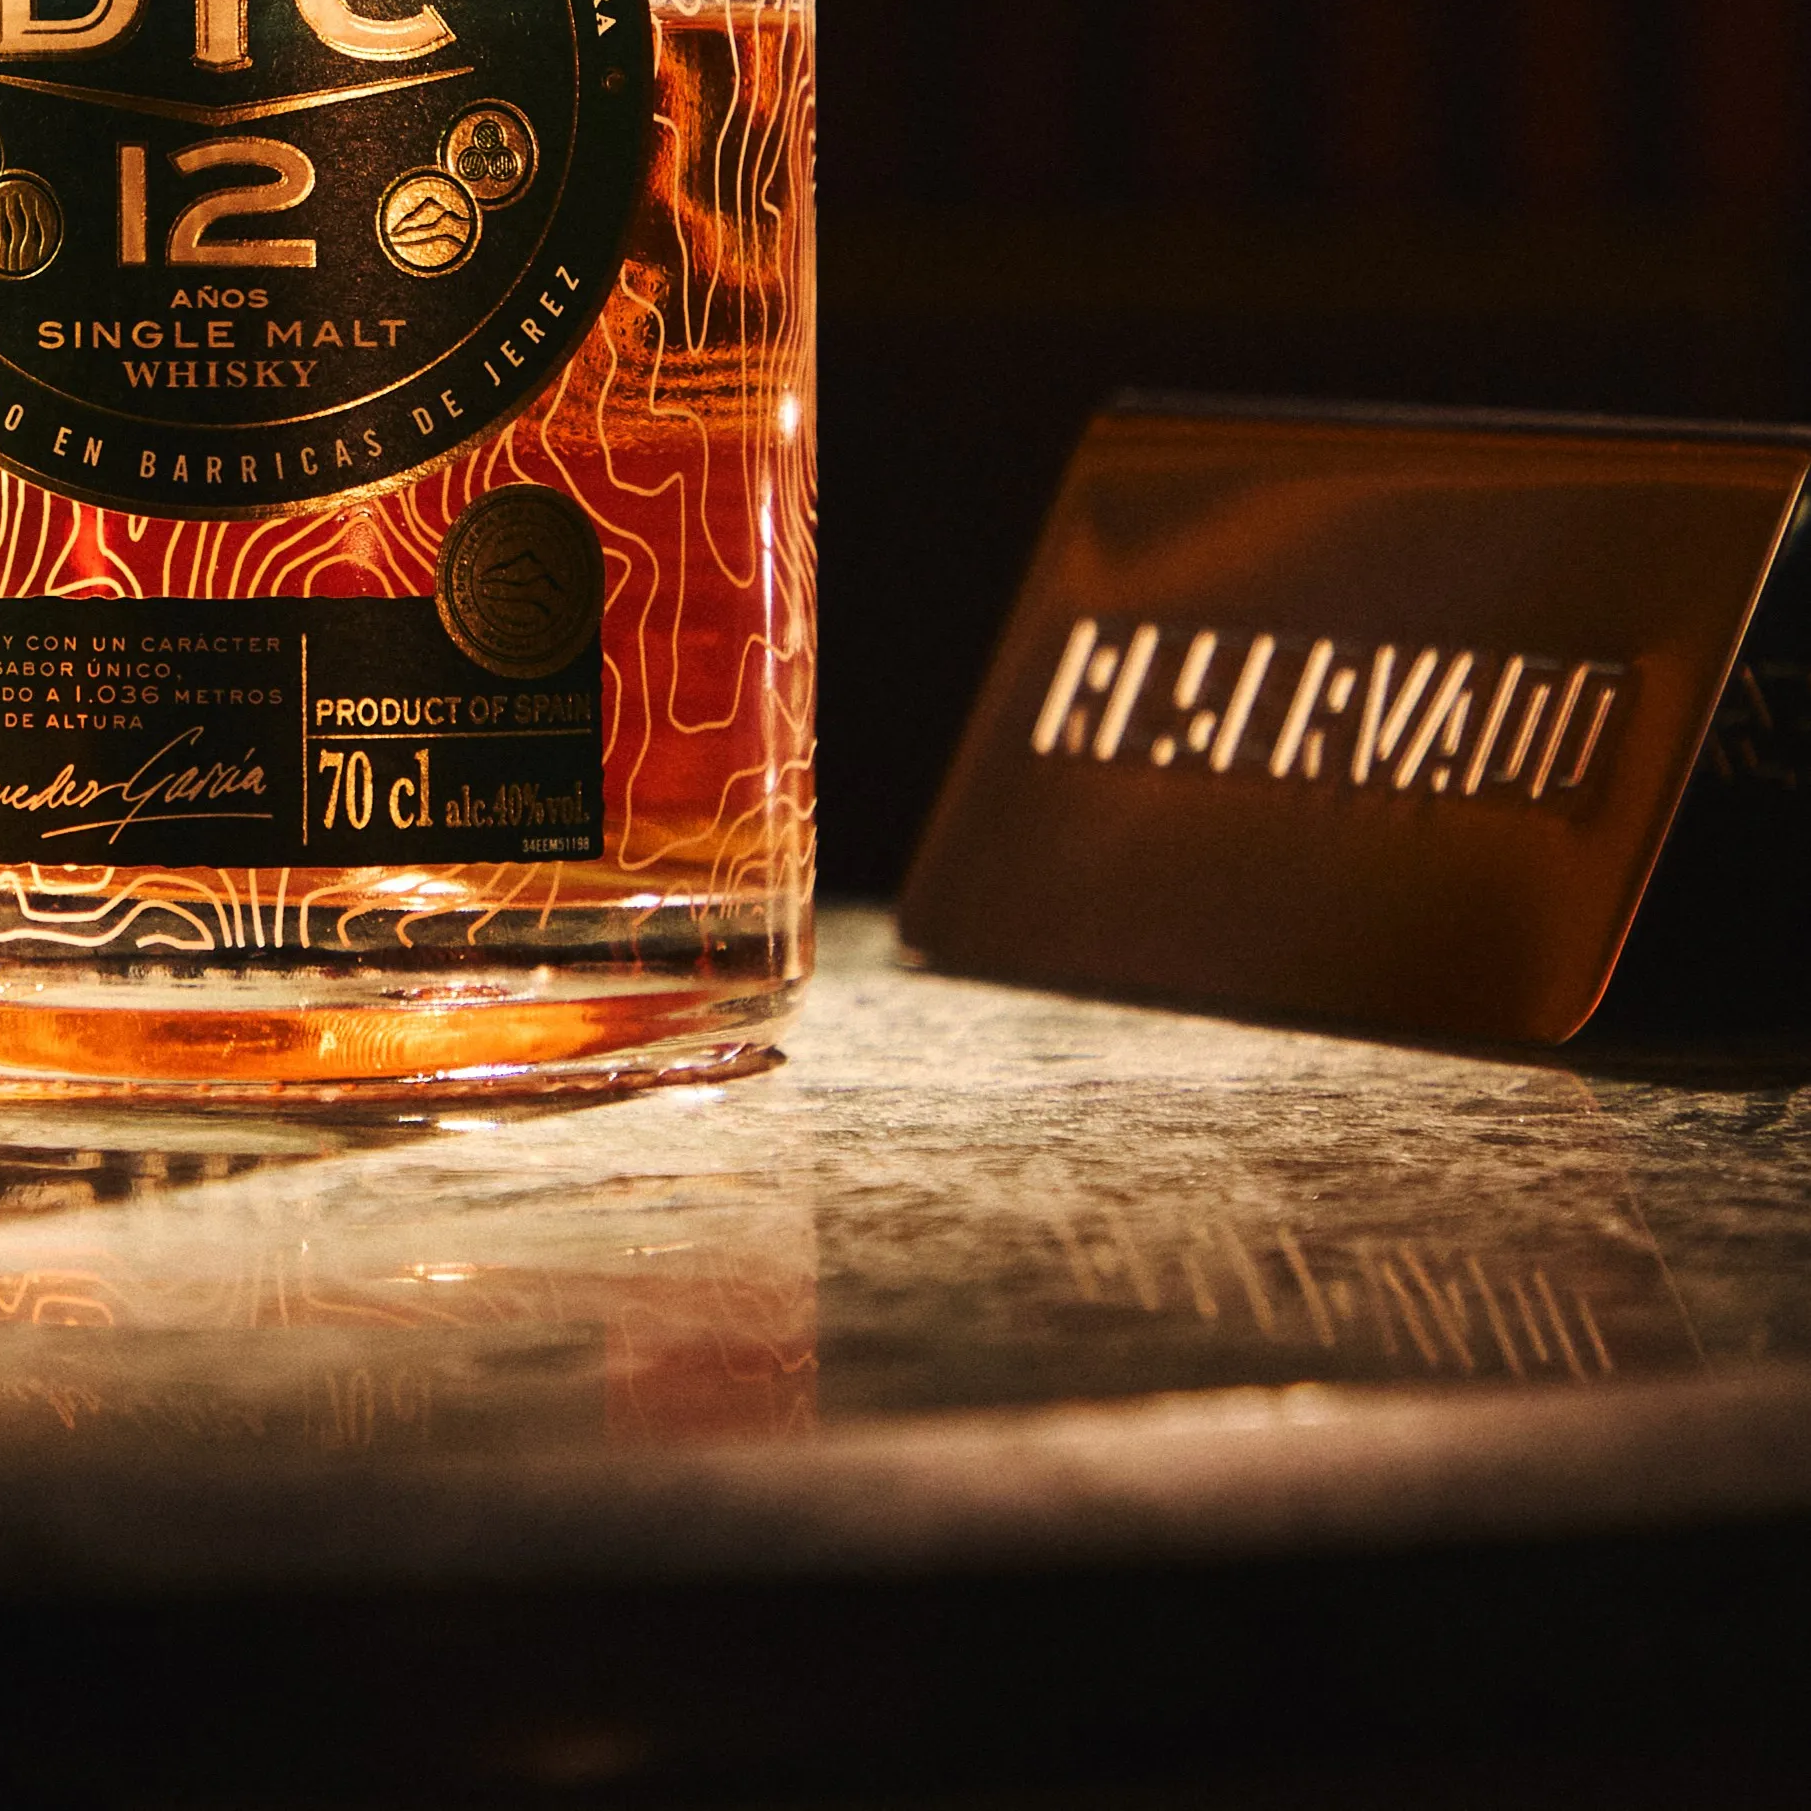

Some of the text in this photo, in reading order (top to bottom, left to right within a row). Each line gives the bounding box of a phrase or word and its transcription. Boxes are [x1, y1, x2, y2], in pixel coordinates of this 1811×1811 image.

[116, 135, 317, 269] 12
[170, 285, 270, 310] AÑOS
[37, 319, 408, 350] SINGLE MALT
[52, 426, 104, 468] EN
[139, 429, 384, 484] BARRICAS
[411, 388, 465, 436] DE
[483, 265, 581, 387] JEREZ
[123, 359, 320, 389] WHISKY
[25, 635, 78, 653] CON
[92, 636, 127, 653] UN
[141, 631, 282, 654] CARÁCTER
[86, 658, 183, 682] ÚNICO,
[46, 688, 61, 703] A
[75, 685, 160, 705] 1.036
[175, 688, 285, 706] METROS
[315, 692, 591, 728] PRODUCT OF SPAIN
[4, 712, 144, 731] DE ALTURA
[318, 748, 434, 830] 70 cl
